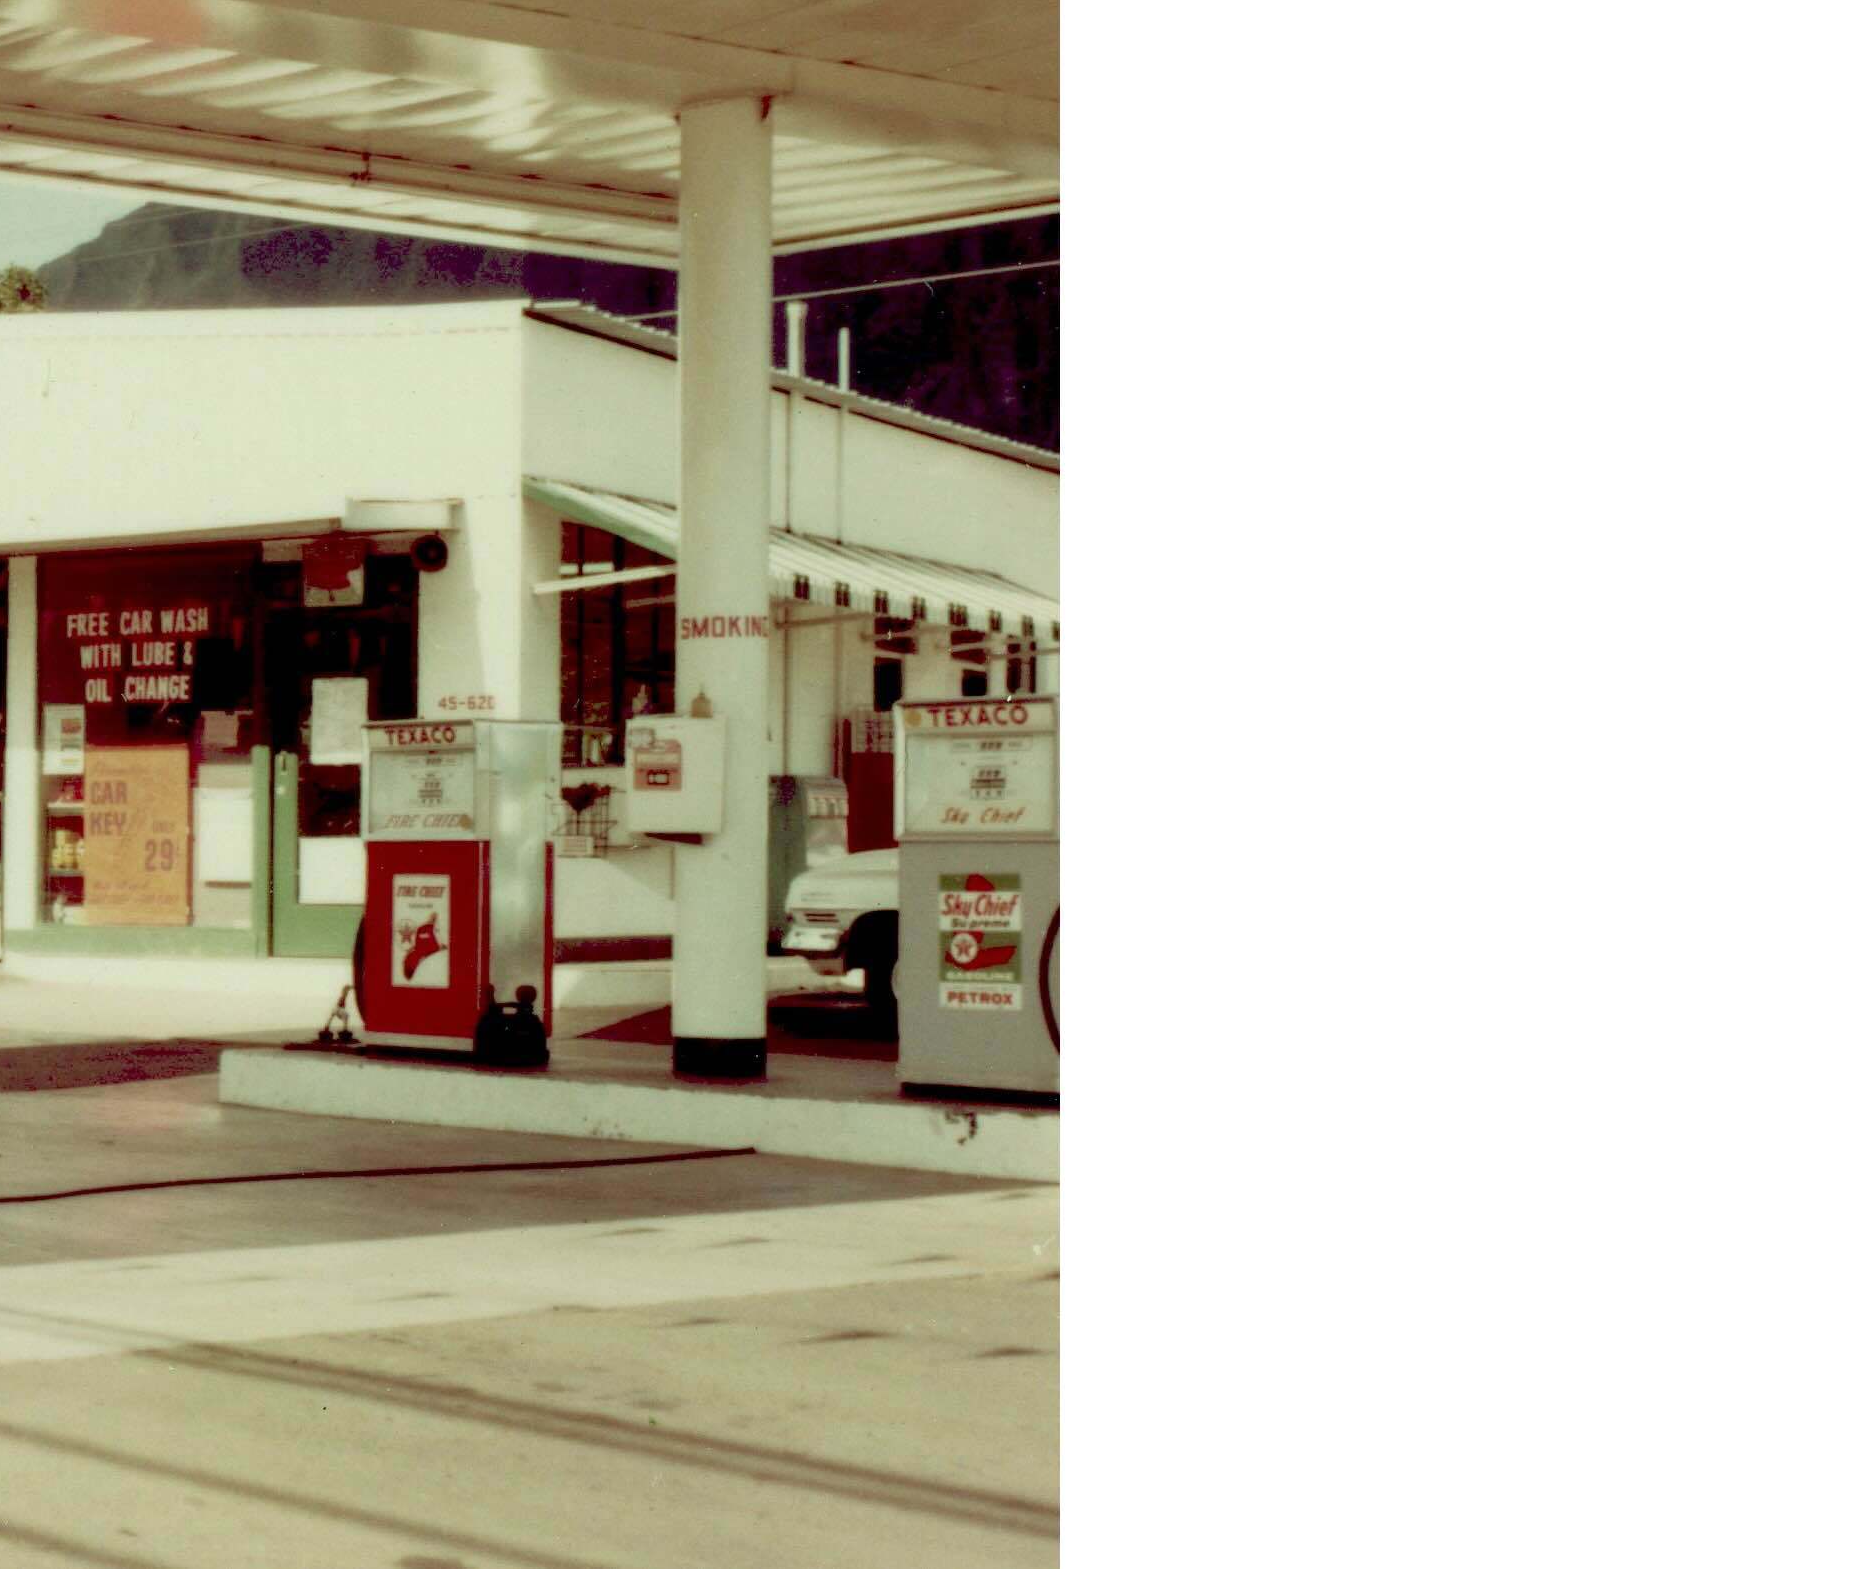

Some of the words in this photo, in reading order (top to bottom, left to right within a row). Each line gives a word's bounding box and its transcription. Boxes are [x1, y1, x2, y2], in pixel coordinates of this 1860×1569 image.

[66, 612, 110, 638] FREE
[120, 609, 153, 636] CAR
[160, 606, 209, 634] WASH
[80, 642, 122, 669] WITH
[131, 641, 176, 666] LUBE
[183, 640, 193, 665] &
[85, 678, 112, 703] OIL
[124, 675, 191, 701] CHANGE
[927, 704, 1029, 727] TEXACO
[383, 725, 457, 746] TEXACO
[90, 781, 128, 805] CAR
[90, 811, 127, 835] KEY
[941, 807, 969, 824] Sky
[979, 807, 1025, 824] Chief
[396, 886, 419, 897] FIRE
[420, 886, 446, 898] CHIEF
[941, 894, 971, 918] Sky
[974, 894, 1019, 917] Chief
[946, 991, 1013, 1005] PETROX
